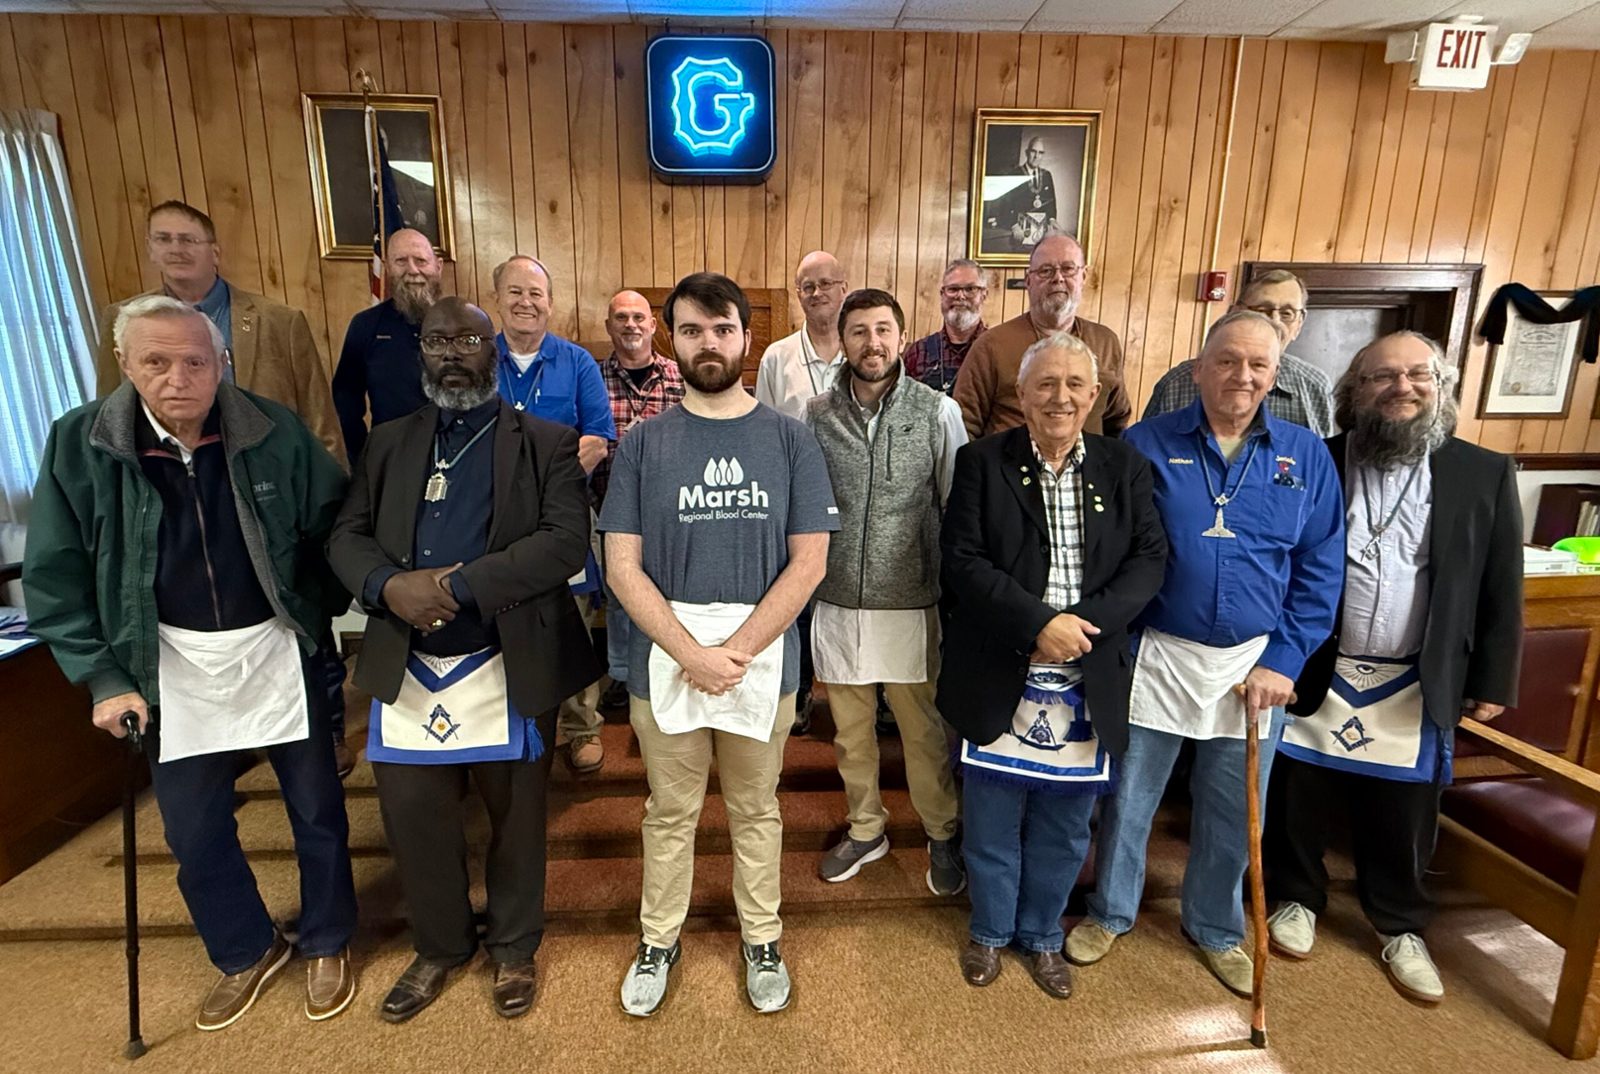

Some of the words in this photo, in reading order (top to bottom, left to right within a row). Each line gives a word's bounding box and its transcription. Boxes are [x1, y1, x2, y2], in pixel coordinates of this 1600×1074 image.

[1436, 29, 1487, 69] EXIT
[671, 56, 755, 156] G
[678, 481, 769, 510] Marsh
[678, 510, 714, 523] Regional
[715, 508, 739, 520] Blood
[741, 509, 769, 520] Center
